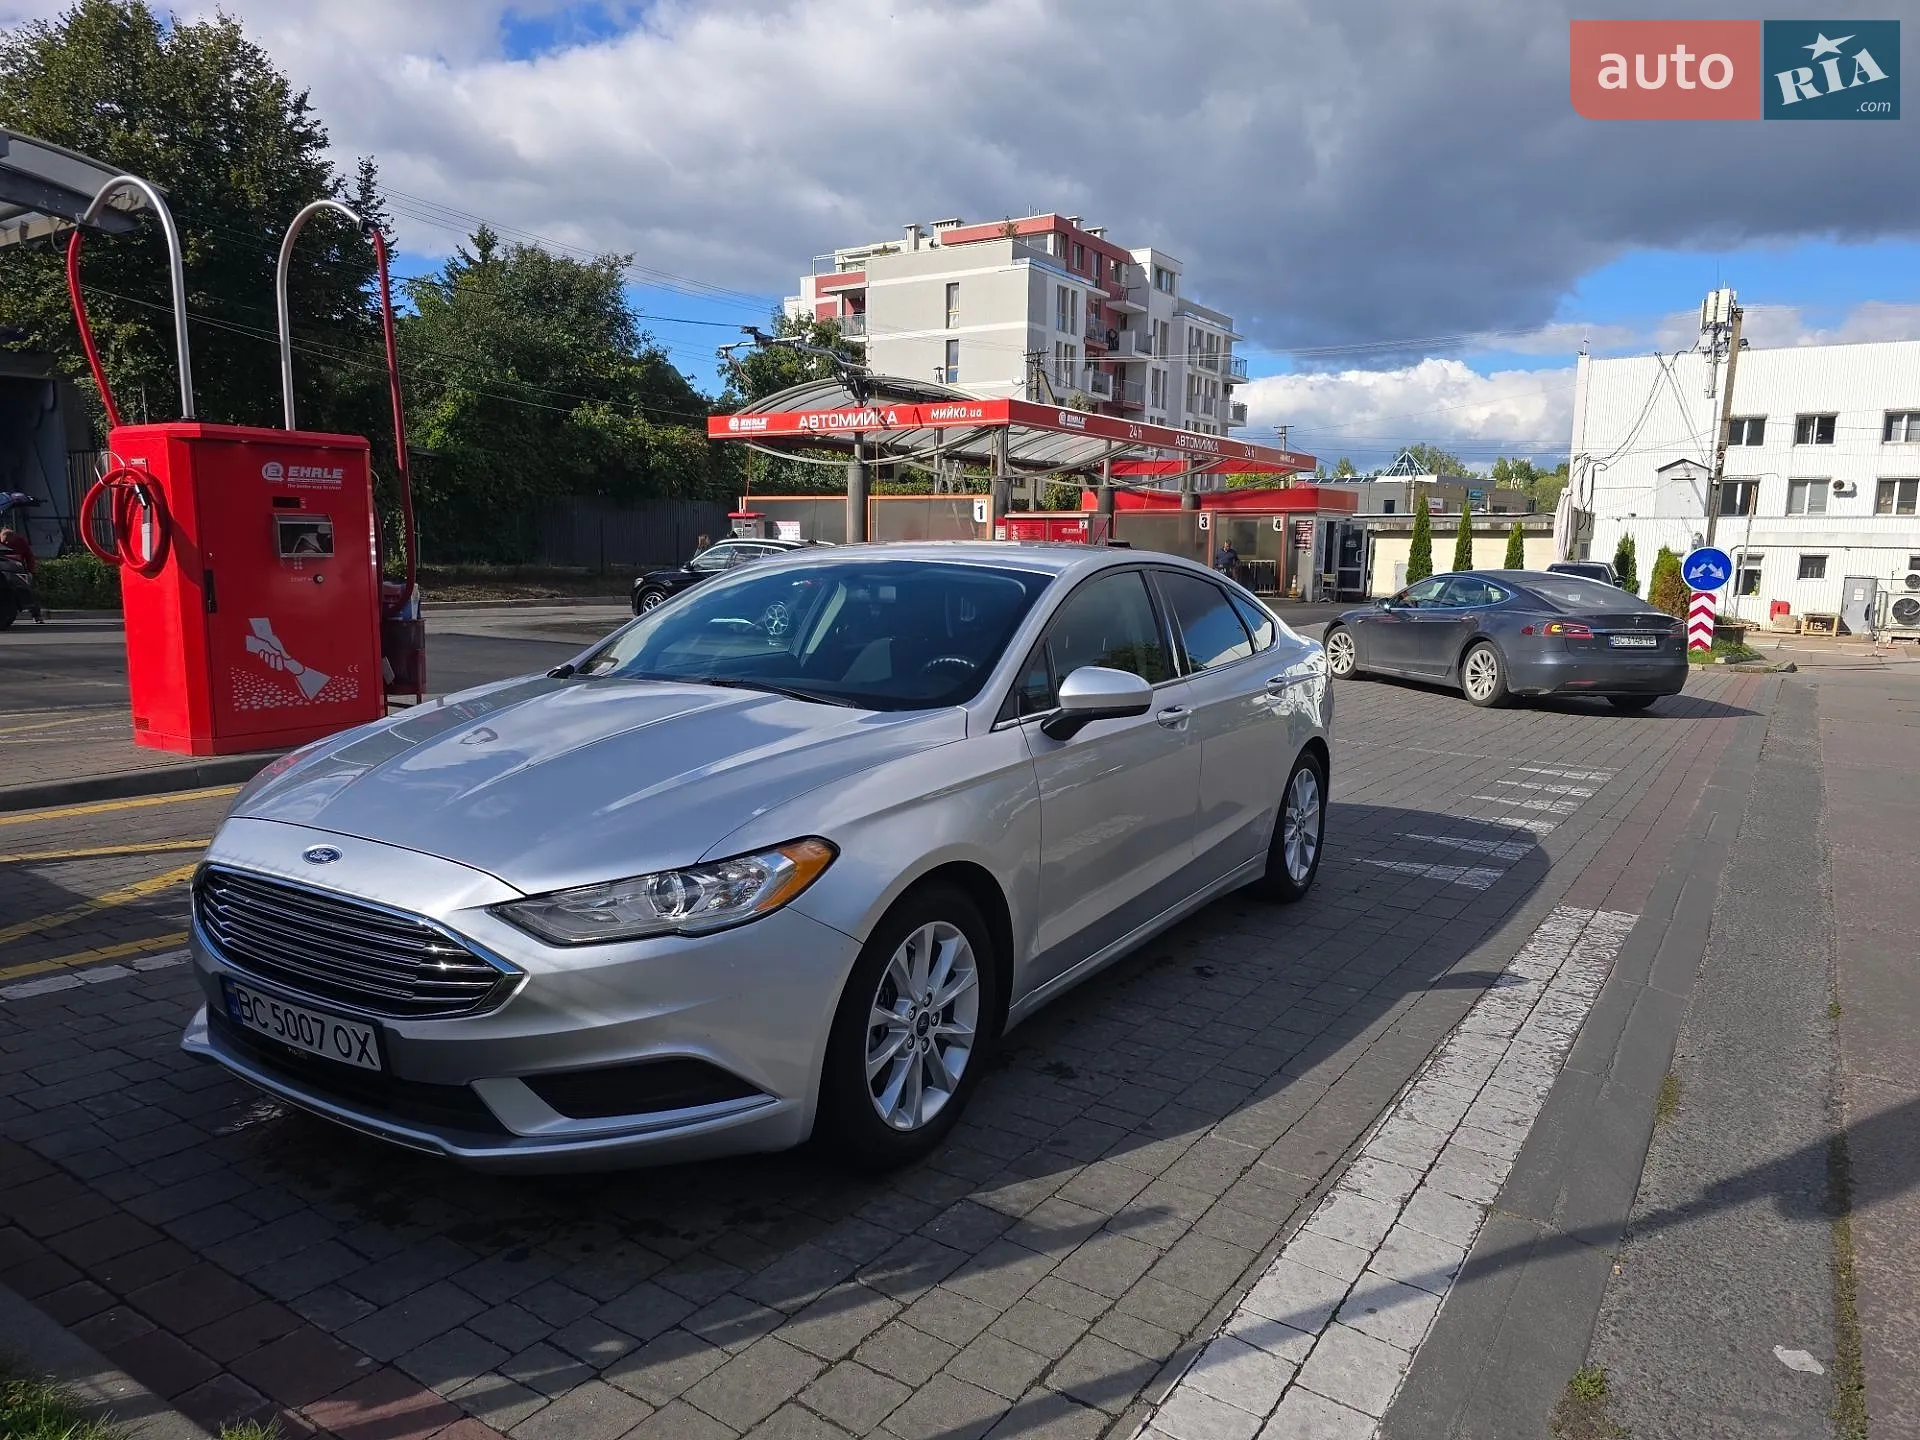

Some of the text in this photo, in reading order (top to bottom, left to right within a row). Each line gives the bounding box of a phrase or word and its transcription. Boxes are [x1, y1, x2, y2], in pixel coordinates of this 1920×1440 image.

[798, 409, 898, 429] АВТОМИЙКА
[1175, 434, 1219, 452] АВТОМИЙКА
[288, 466, 344, 479] EHRLE
[977, 505, 984, 520] 1
[1201, 517, 1208, 528] 3
[1275, 520, 1281, 530] 4
[235, 987, 269, 1029] BC
[270, 1002, 326, 1050] 5007
[334, 1024, 376, 1067] OX
